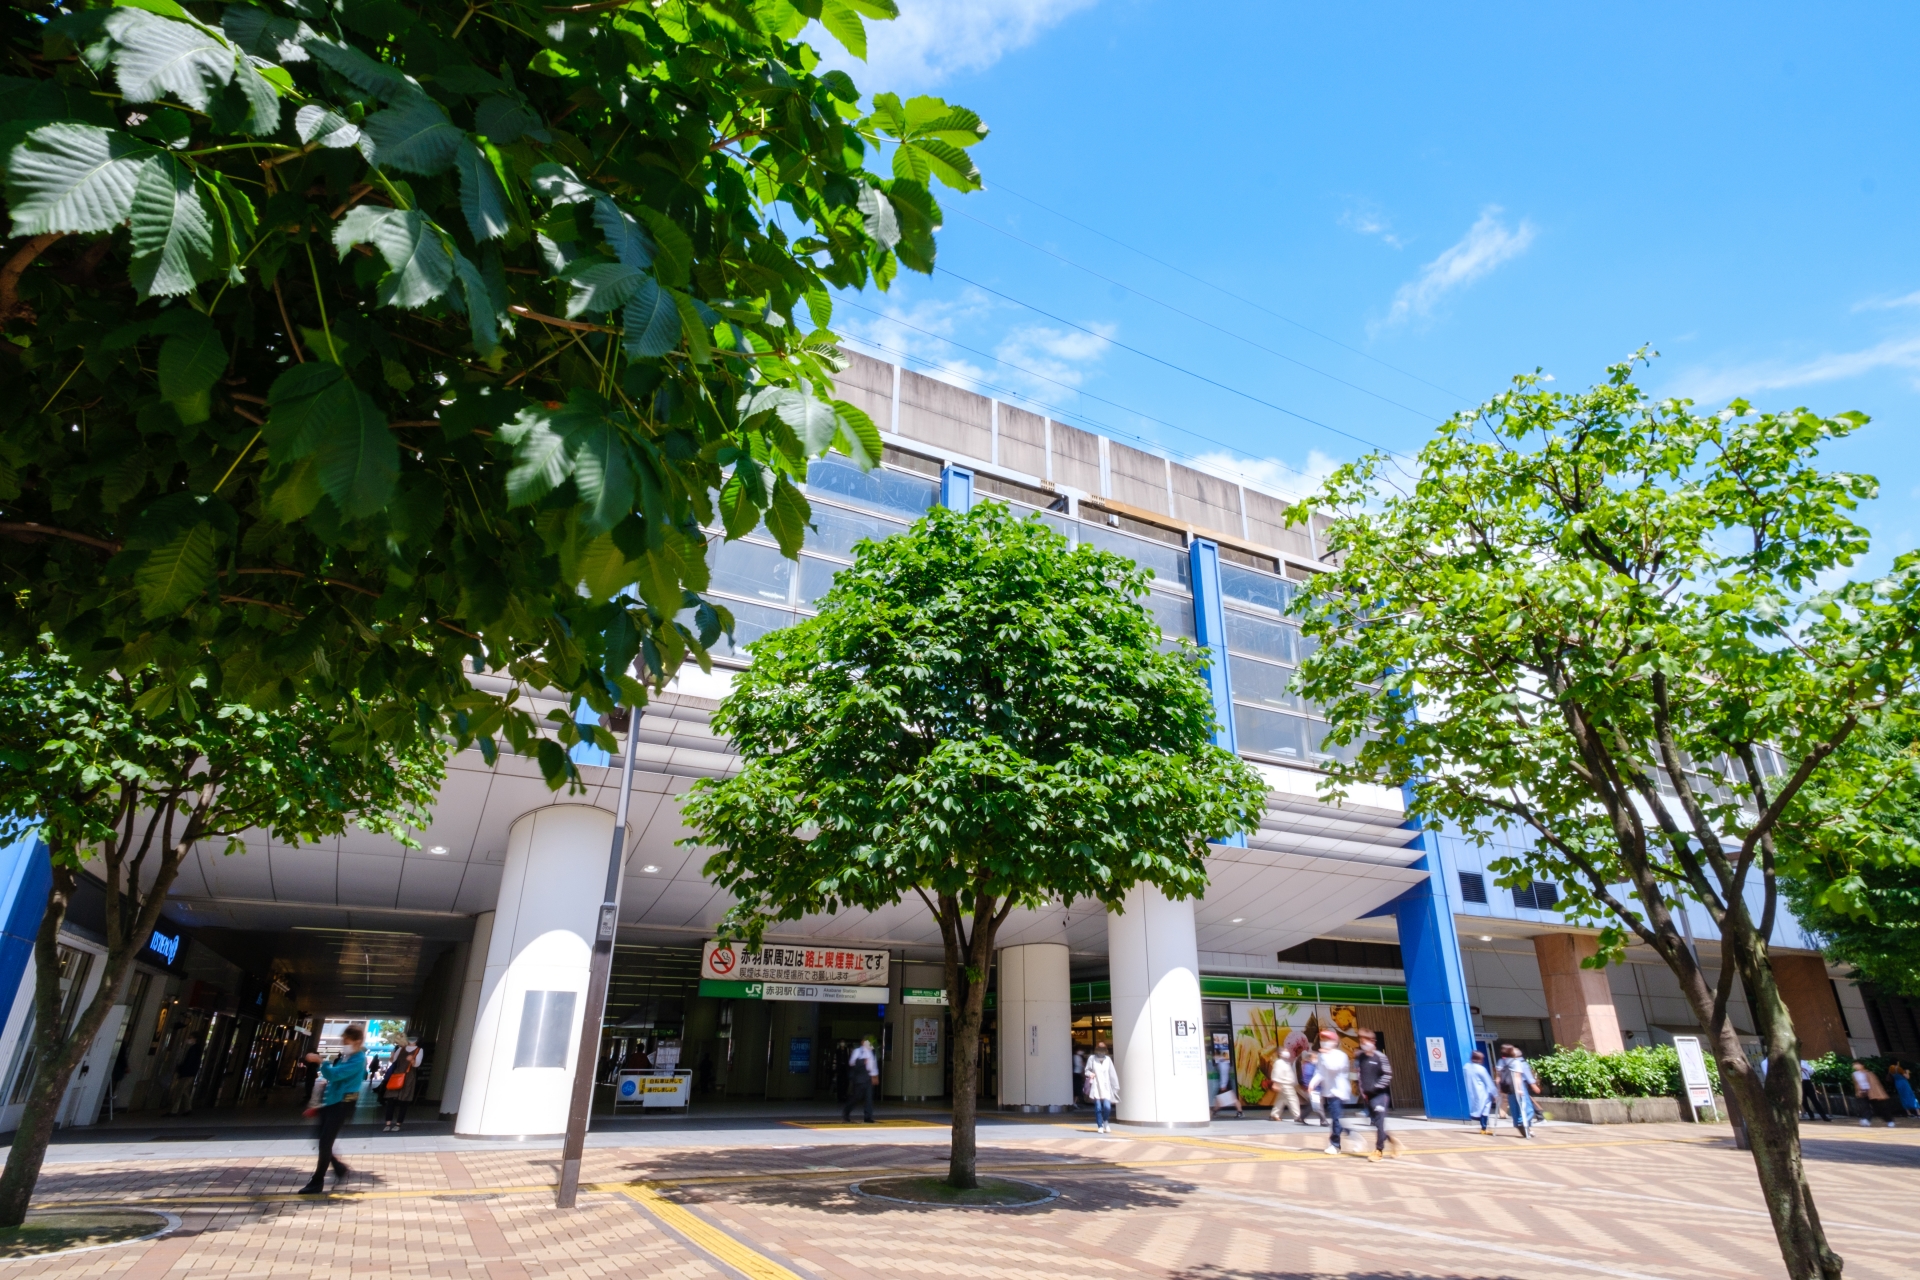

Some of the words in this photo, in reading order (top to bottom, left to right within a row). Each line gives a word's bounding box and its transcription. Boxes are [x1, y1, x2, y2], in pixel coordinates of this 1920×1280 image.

[740, 948, 885, 971] 赤羽駅周辺は路上喫煙禁止です。
[745, 984, 762, 994] JR
[765, 986, 818, 998] 赤羽駅(西口)
[1266, 984, 1303, 997] NewDays
